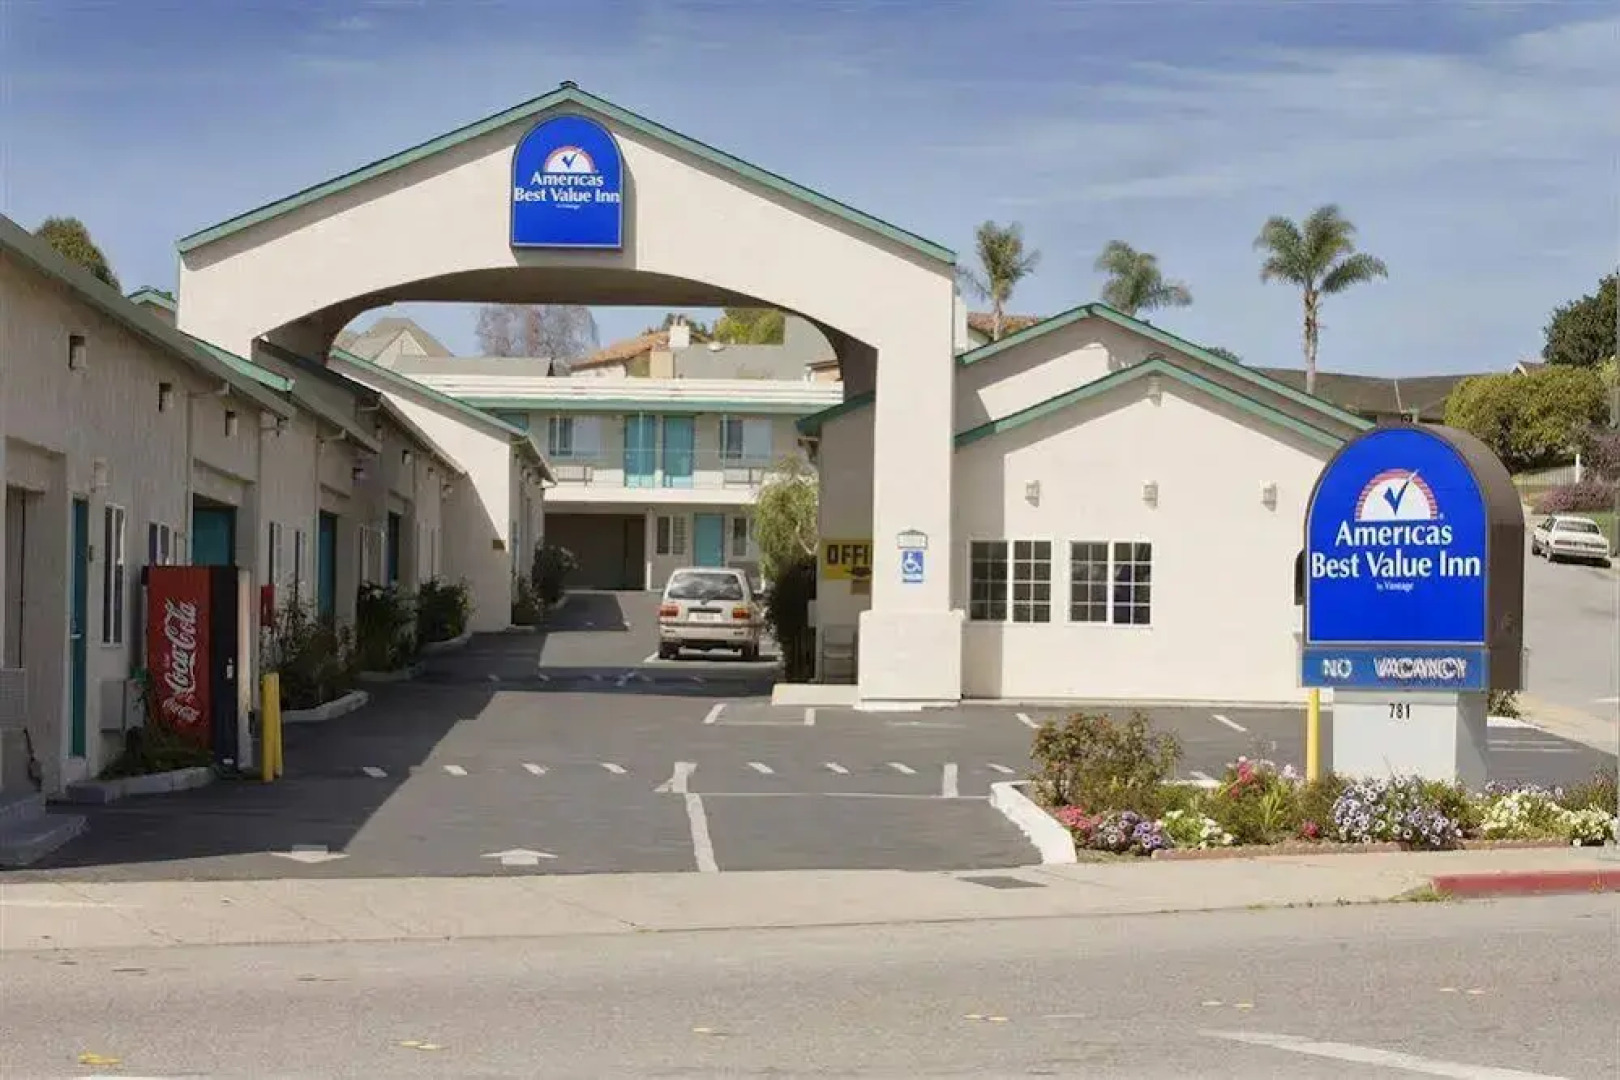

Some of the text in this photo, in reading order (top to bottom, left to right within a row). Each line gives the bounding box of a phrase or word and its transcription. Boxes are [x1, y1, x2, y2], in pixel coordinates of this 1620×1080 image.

[531, 171, 604, 187] Americas
[514, 187, 620, 203] Best Value Inn
[1335, 520, 1453, 547] Americas
[827, 544, 873, 565] OFFI
[1311, 548, 1481, 578] Best Value Inn
[1322, 656, 1467, 680] NO VACANCY
[1389, 703, 1411, 719] 781
